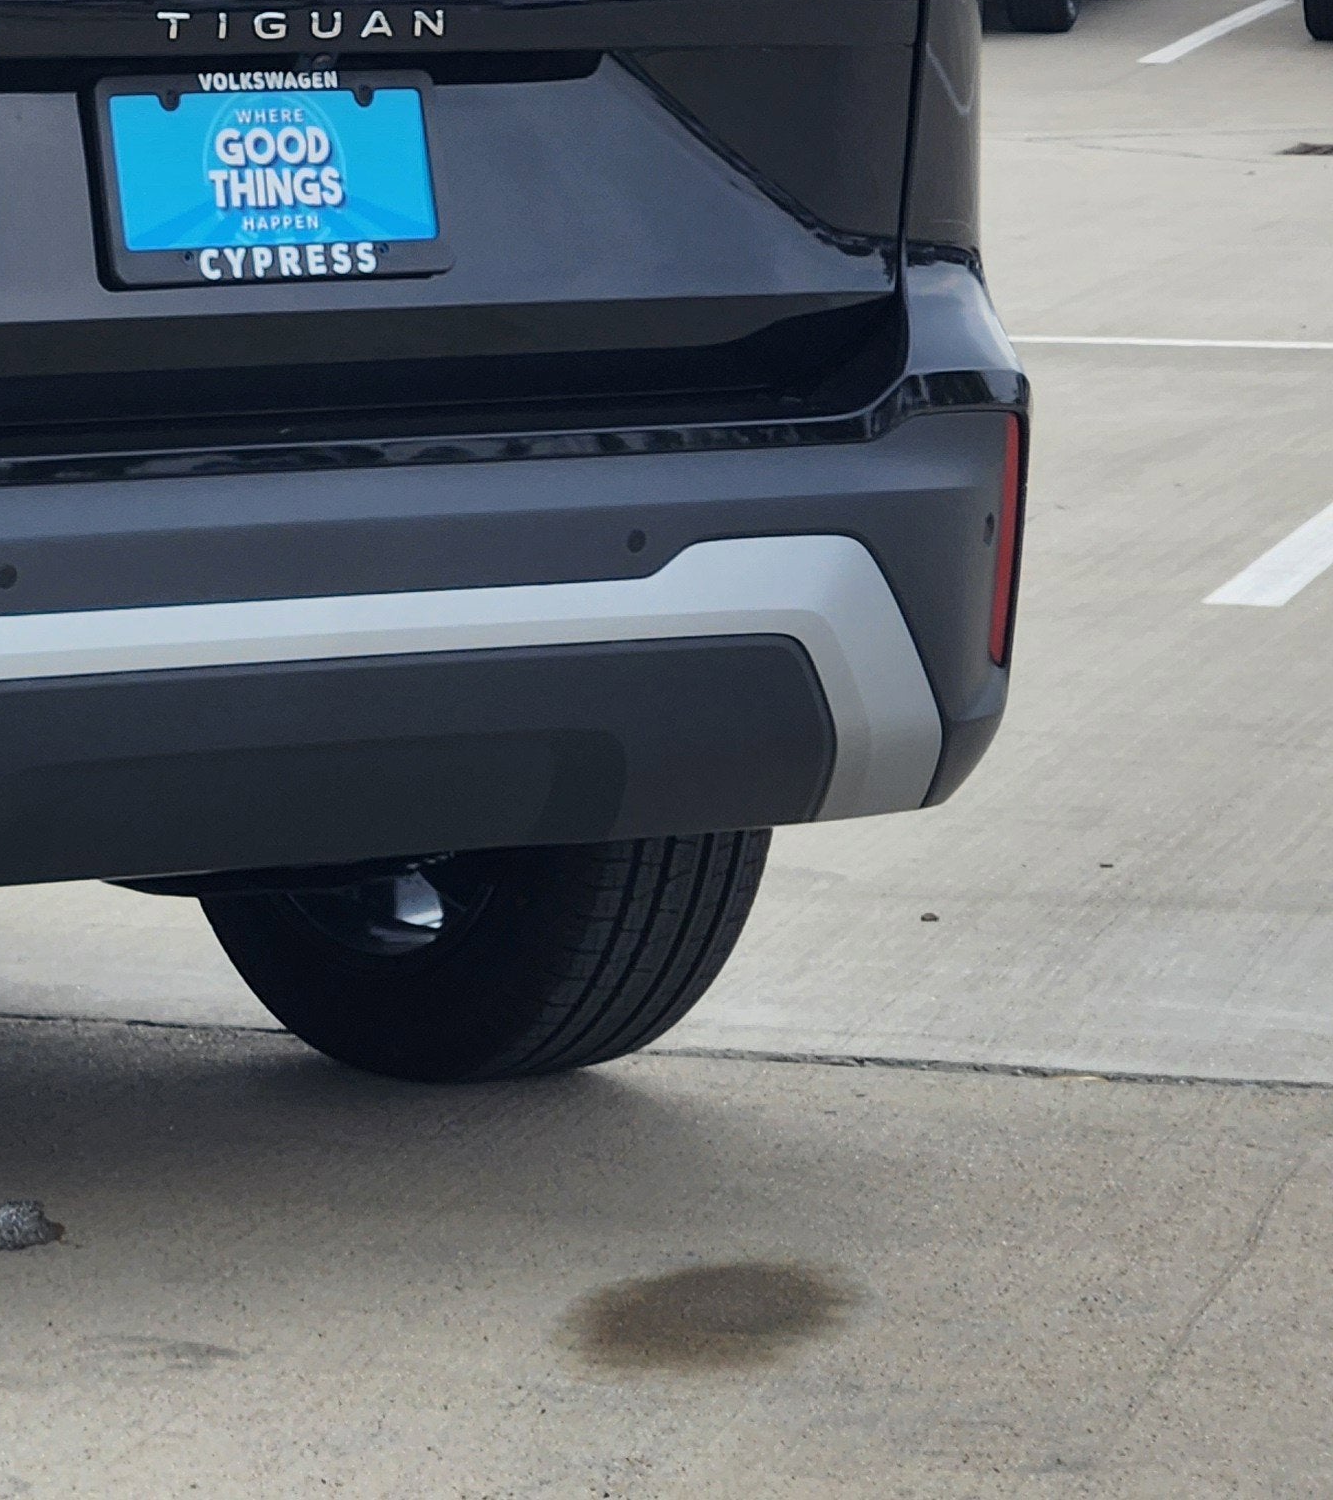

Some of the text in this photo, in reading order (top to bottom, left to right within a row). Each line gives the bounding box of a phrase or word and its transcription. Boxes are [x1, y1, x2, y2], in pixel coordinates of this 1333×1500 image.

[157, 10, 445, 40] TIGUAN
[198, 71, 338, 91] VOLKSWAGEN
[235, 108, 305, 124] WHERE
[215, 126, 330, 166] GOOD
[208, 167, 343, 208] THINGS
[243, 214, 319, 231] HAPPEN
[199, 242, 377, 280] CYPRESS
